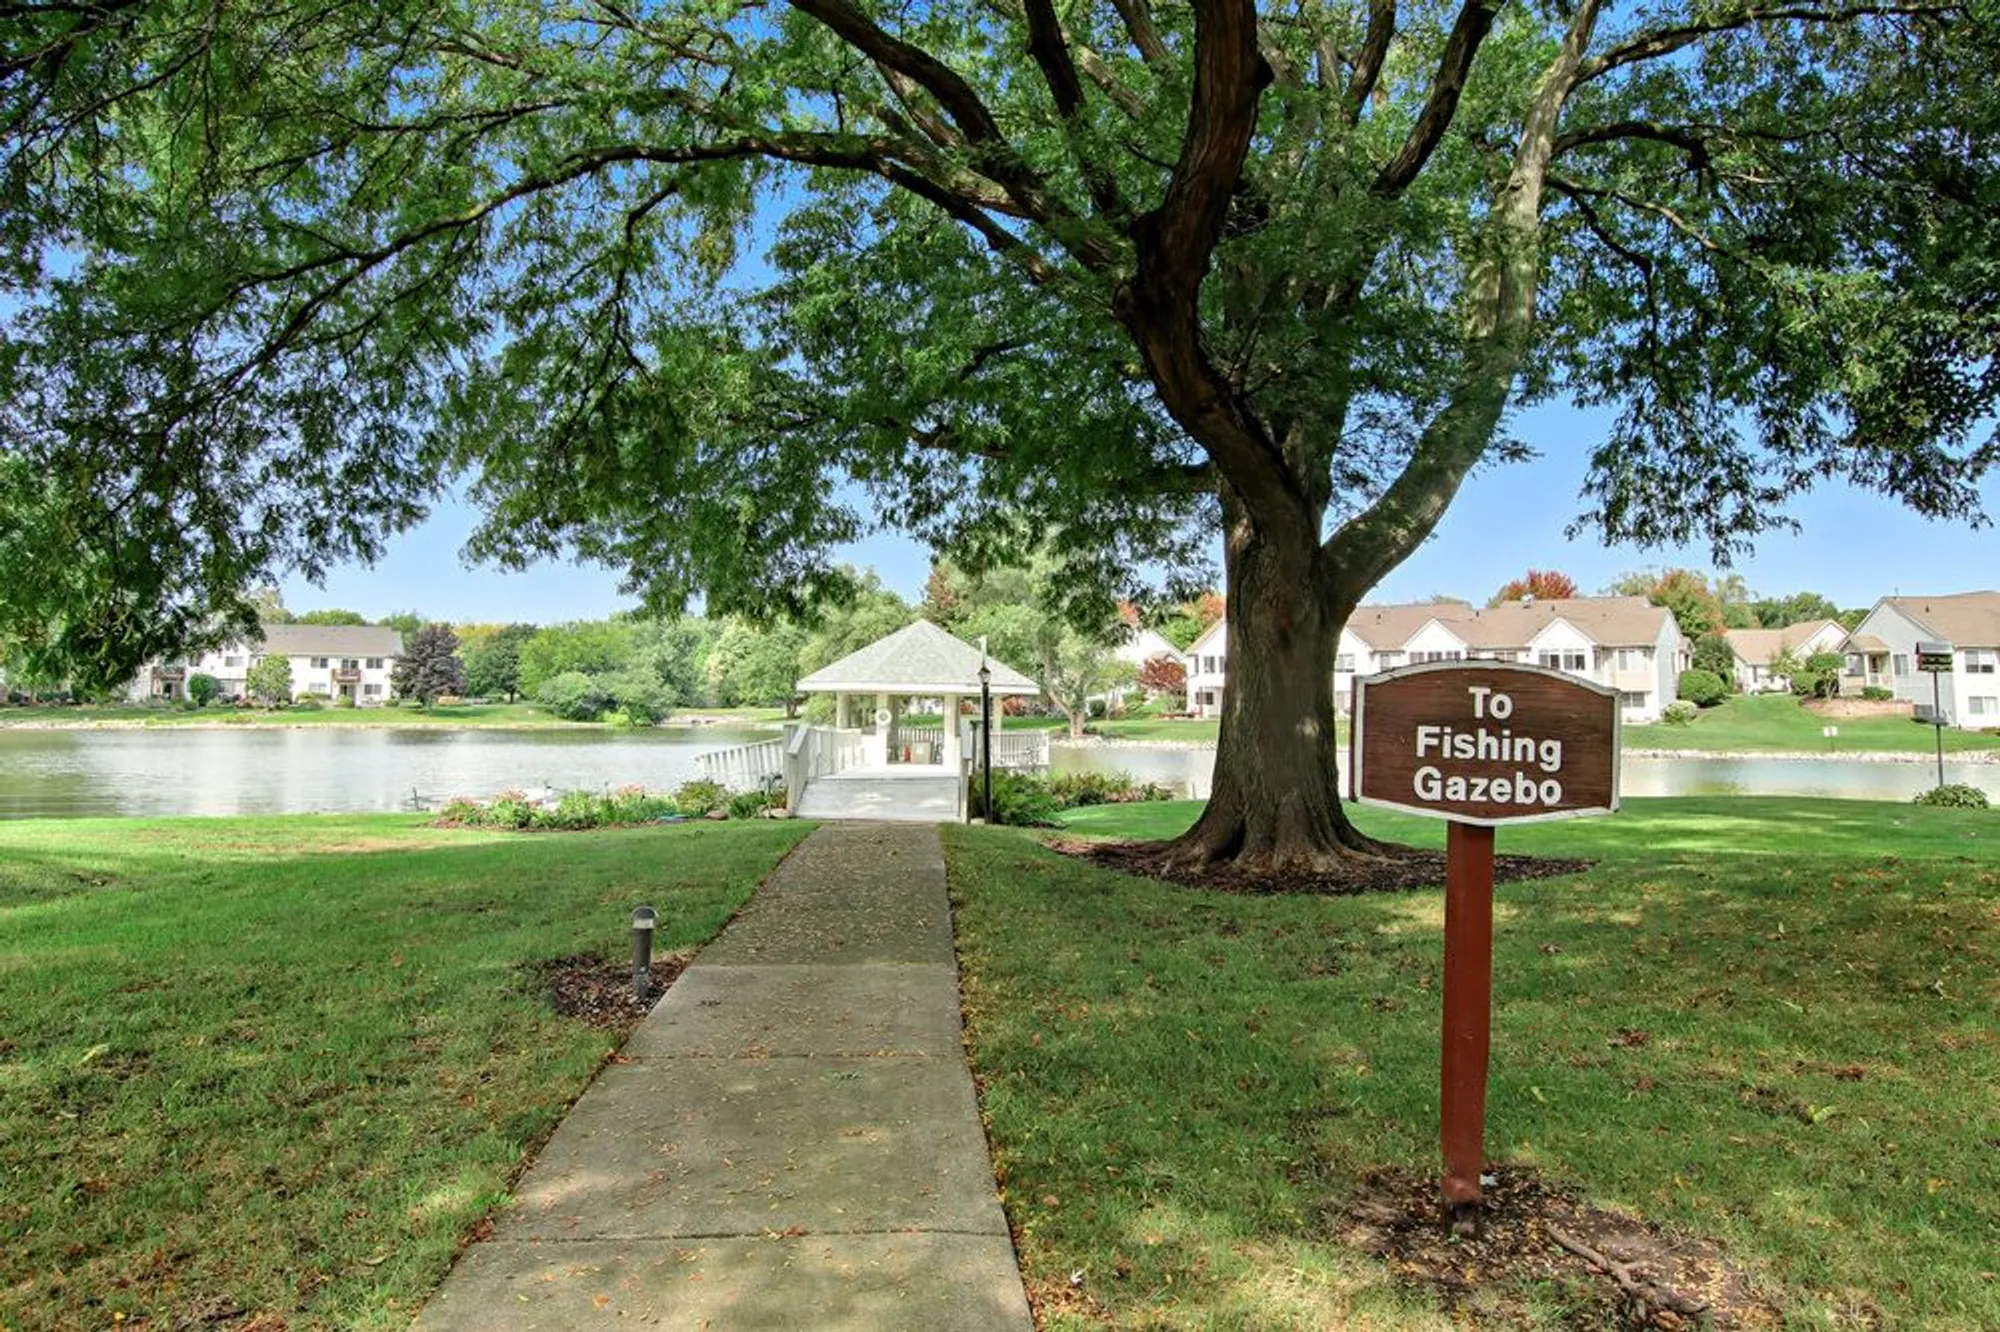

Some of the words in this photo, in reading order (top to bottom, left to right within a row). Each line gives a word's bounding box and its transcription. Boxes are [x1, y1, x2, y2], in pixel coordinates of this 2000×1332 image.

[1468, 686, 1513, 719] To
[1416, 725, 1562, 772] Fishing
[1413, 766, 1563, 806] Gazebo
